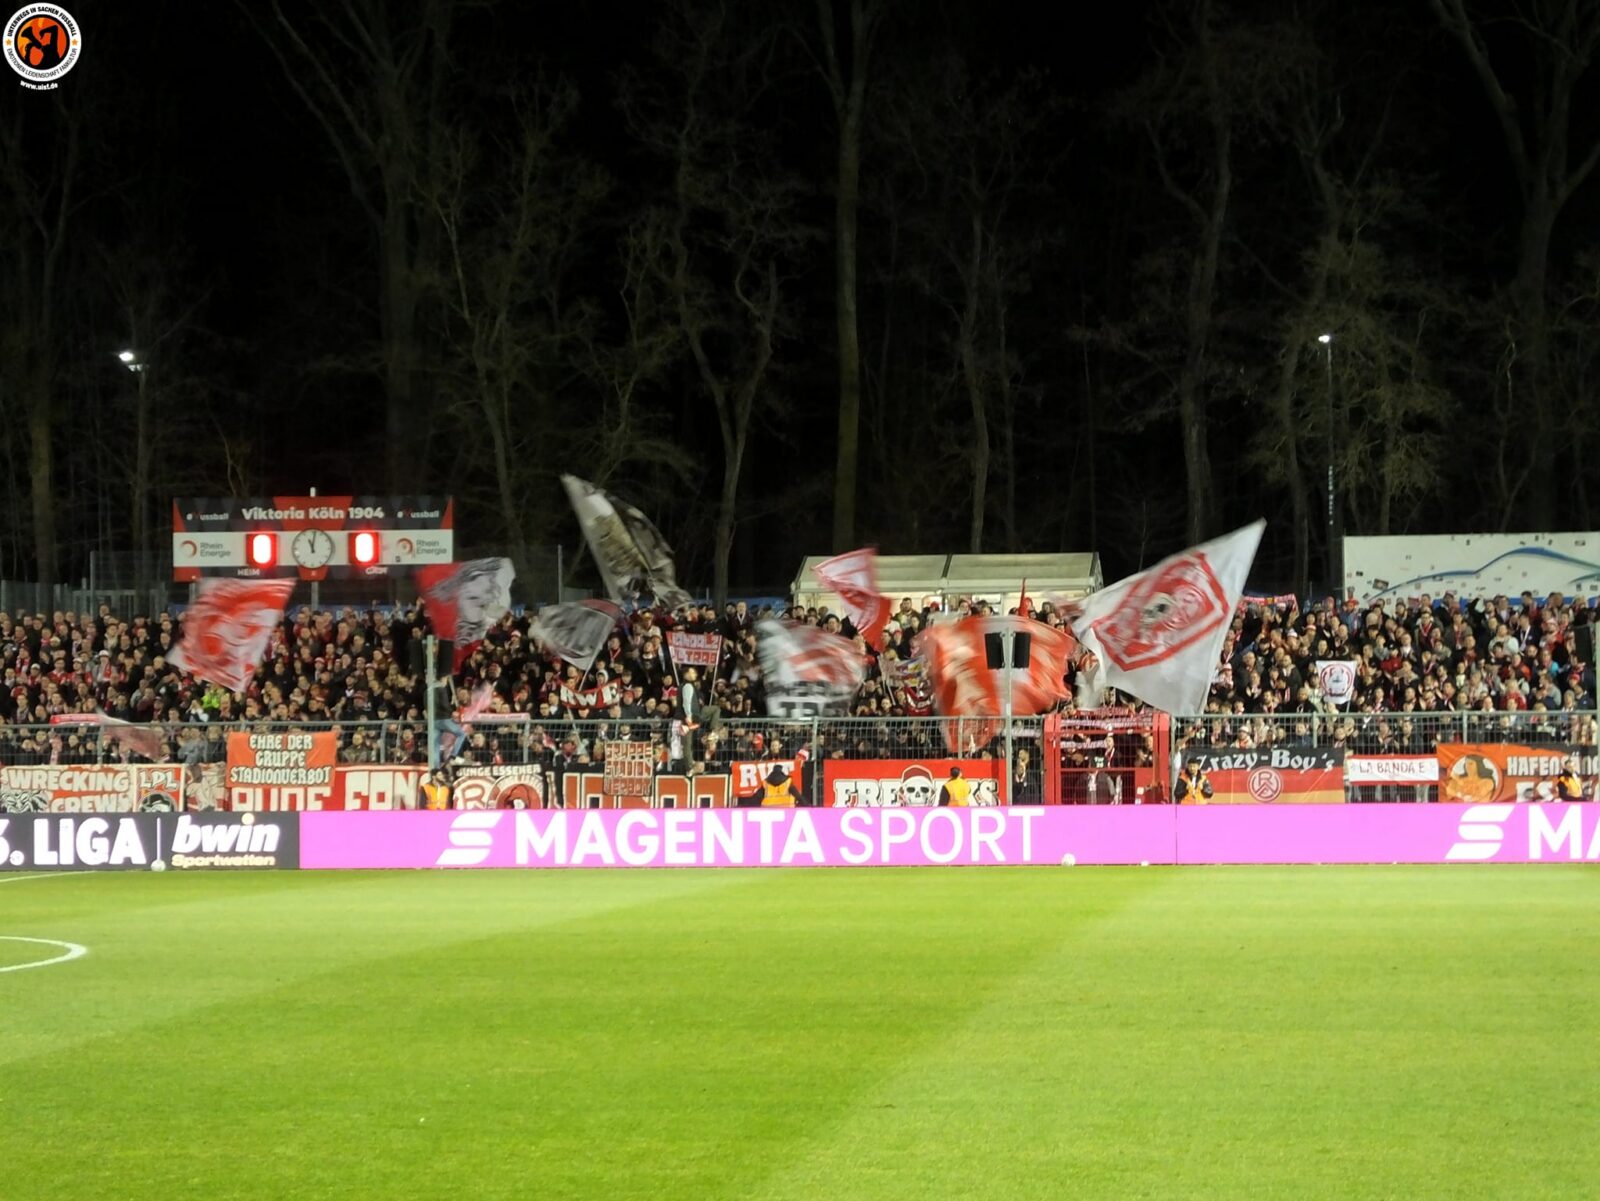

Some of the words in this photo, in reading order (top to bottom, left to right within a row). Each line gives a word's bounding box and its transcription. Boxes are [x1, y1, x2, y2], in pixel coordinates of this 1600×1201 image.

[242, 506, 305, 520] Viktoria
[308, 507, 345, 520] Köln
[348, 506, 385, 520] 1904
[200, 550, 231, 558] Energie
[416, 547, 447, 555] Energie
[249, 734, 283, 750] EHRE
[287, 734, 313, 750] DER
[255, 750, 306, 767] GRUPPE
[456, 766, 491, 777] JUNGE
[492, 763, 542, 776] ESSENER
[8, 769, 130, 792] WRECKING
[172, 813, 280, 853] bwin
[515, 809, 825, 864] MAGENTA
[839, 807, 1045, 864] SPORT
[33, 817, 147, 865] LIGA
[171, 854, 276, 869] Sportwetten
